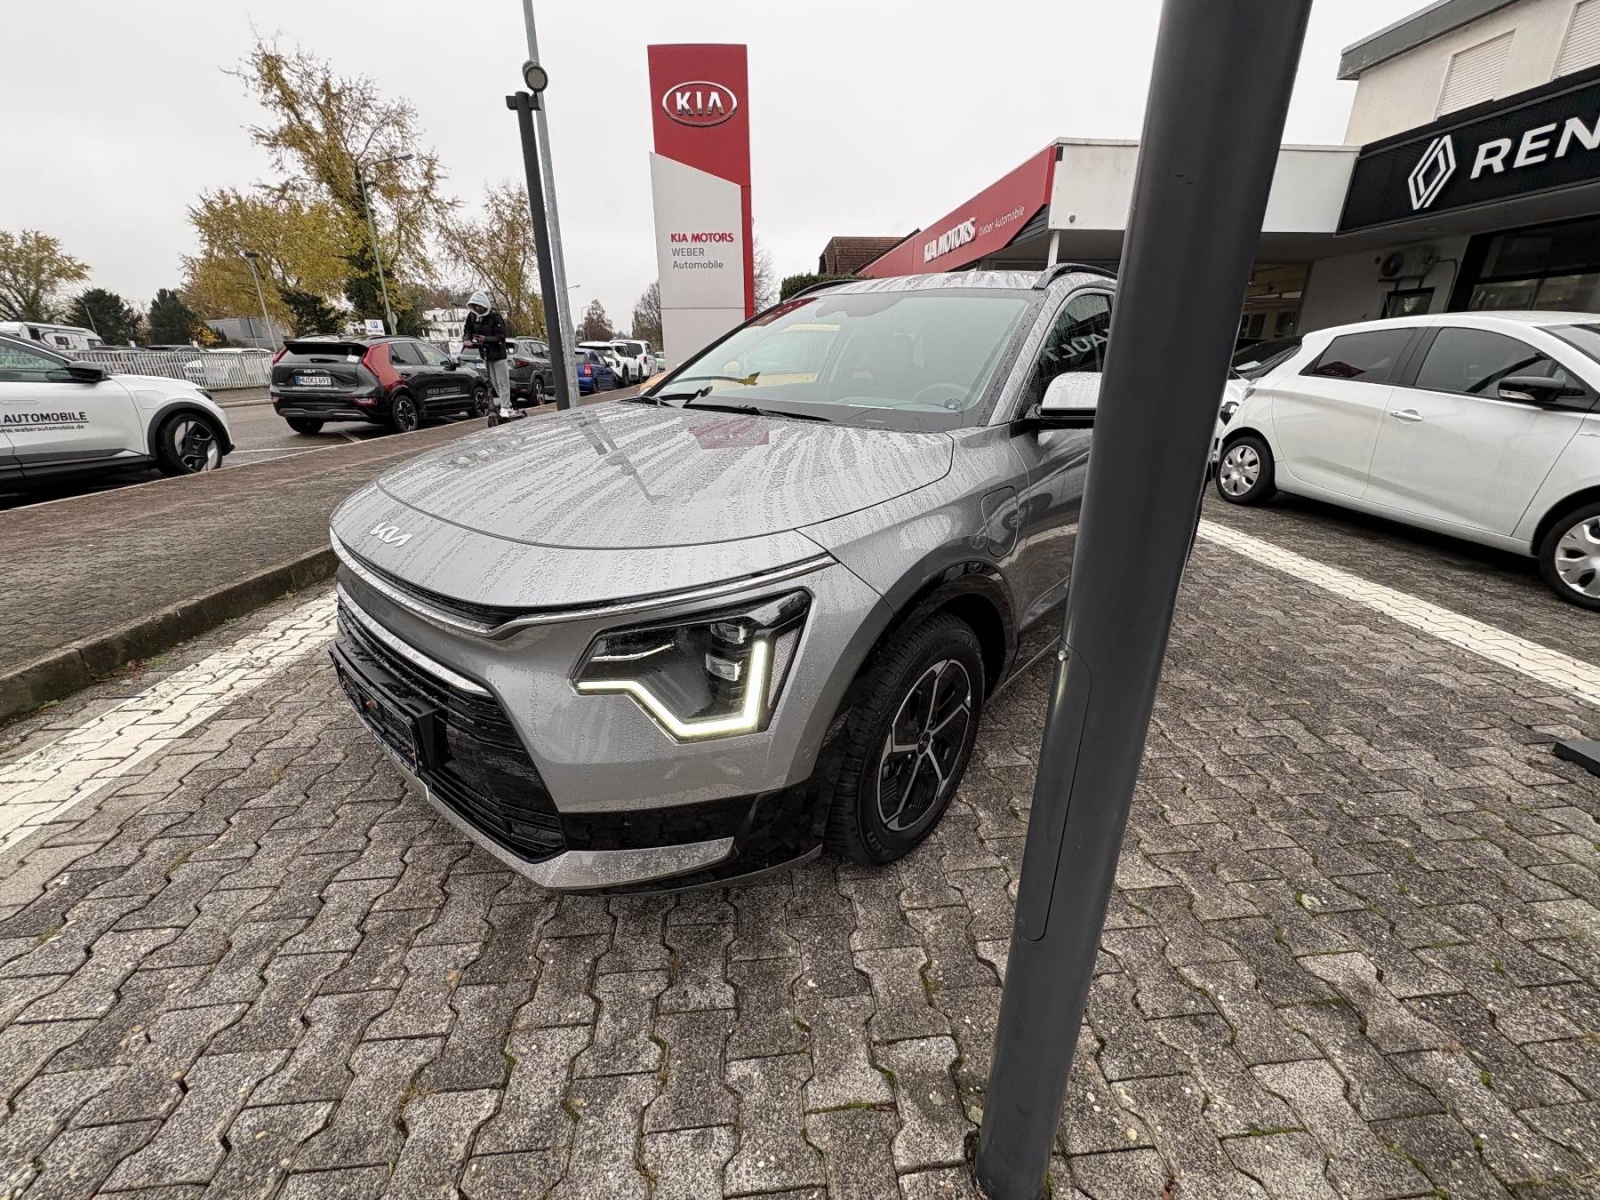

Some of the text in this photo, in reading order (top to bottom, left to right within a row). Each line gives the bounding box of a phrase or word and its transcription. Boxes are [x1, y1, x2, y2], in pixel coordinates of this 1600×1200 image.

[675, 91, 724, 115] KIA
[670, 232, 734, 243] KIA MOTORS
[924, 240, 938, 263] KIA
[938, 217, 976, 256] MOTORS
[671, 247, 705, 257] WEBER
[672, 260, 724, 269] Automobile
[4, 411, 87, 424] AUTOMOBILE
